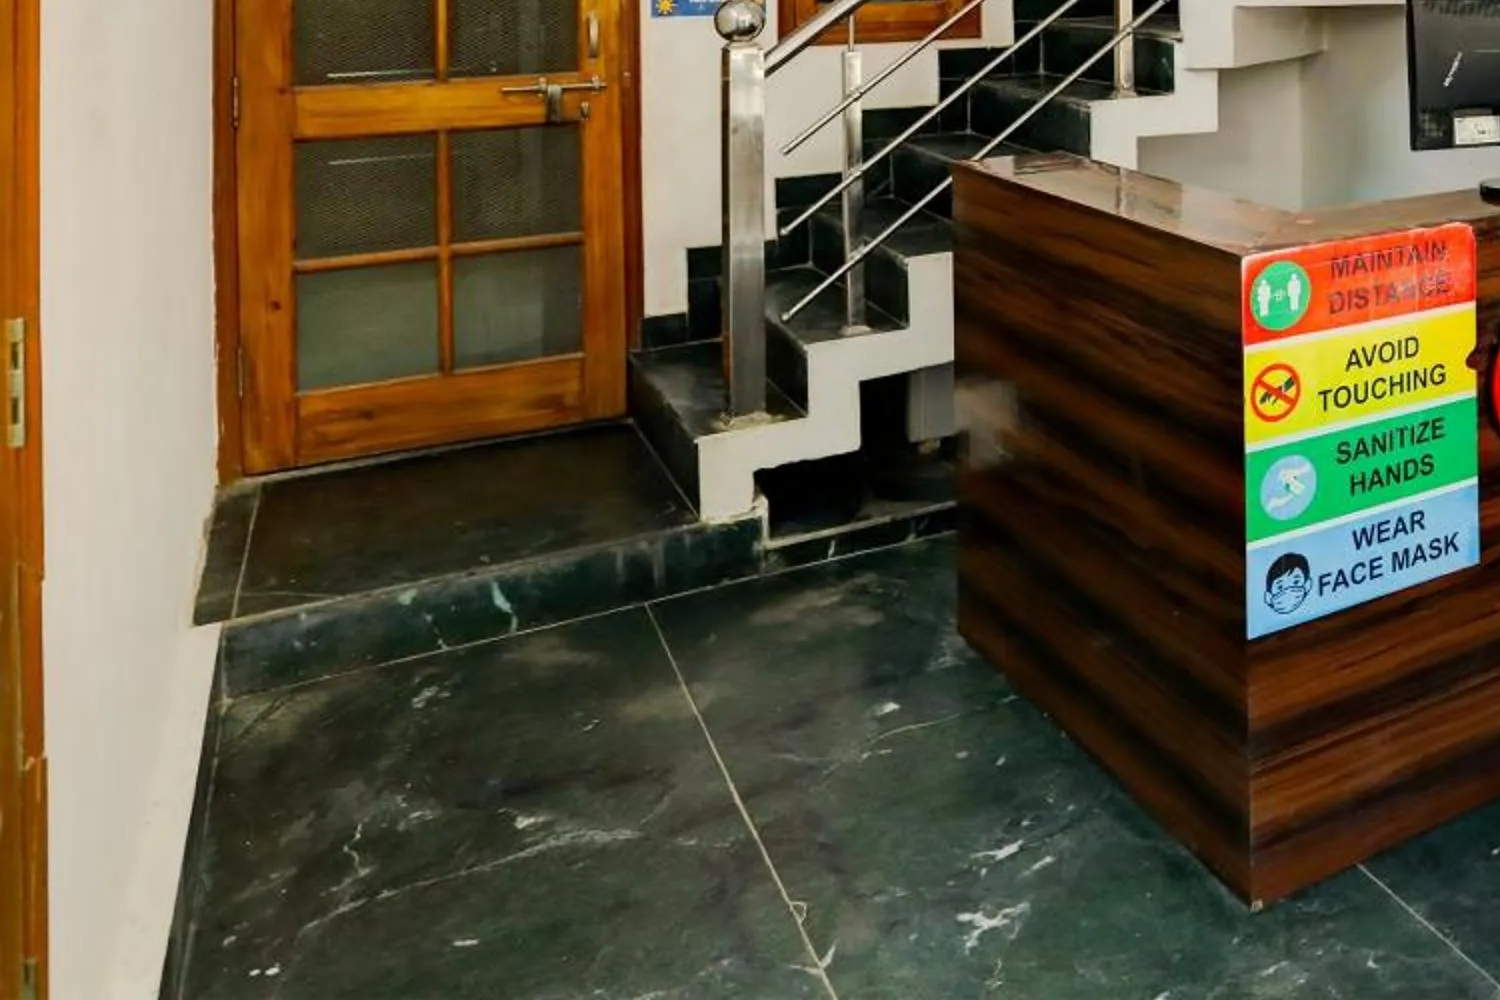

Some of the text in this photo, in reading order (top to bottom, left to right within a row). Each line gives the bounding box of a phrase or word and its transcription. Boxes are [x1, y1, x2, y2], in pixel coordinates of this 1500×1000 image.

[1330, 240, 1447, 279] MAINTAIN
[1328, 270, 1451, 315] DISTANCE
[1345, 336, 1420, 373] AVOID
[1318, 363, 1447, 412] TOUCHING
[1335, 417, 1445, 465] SANITIZE
[1350, 453, 1435, 496] HANDS
[1352, 510, 1425, 551] WEAR
[1318, 532, 1460, 597] FACE MASK
